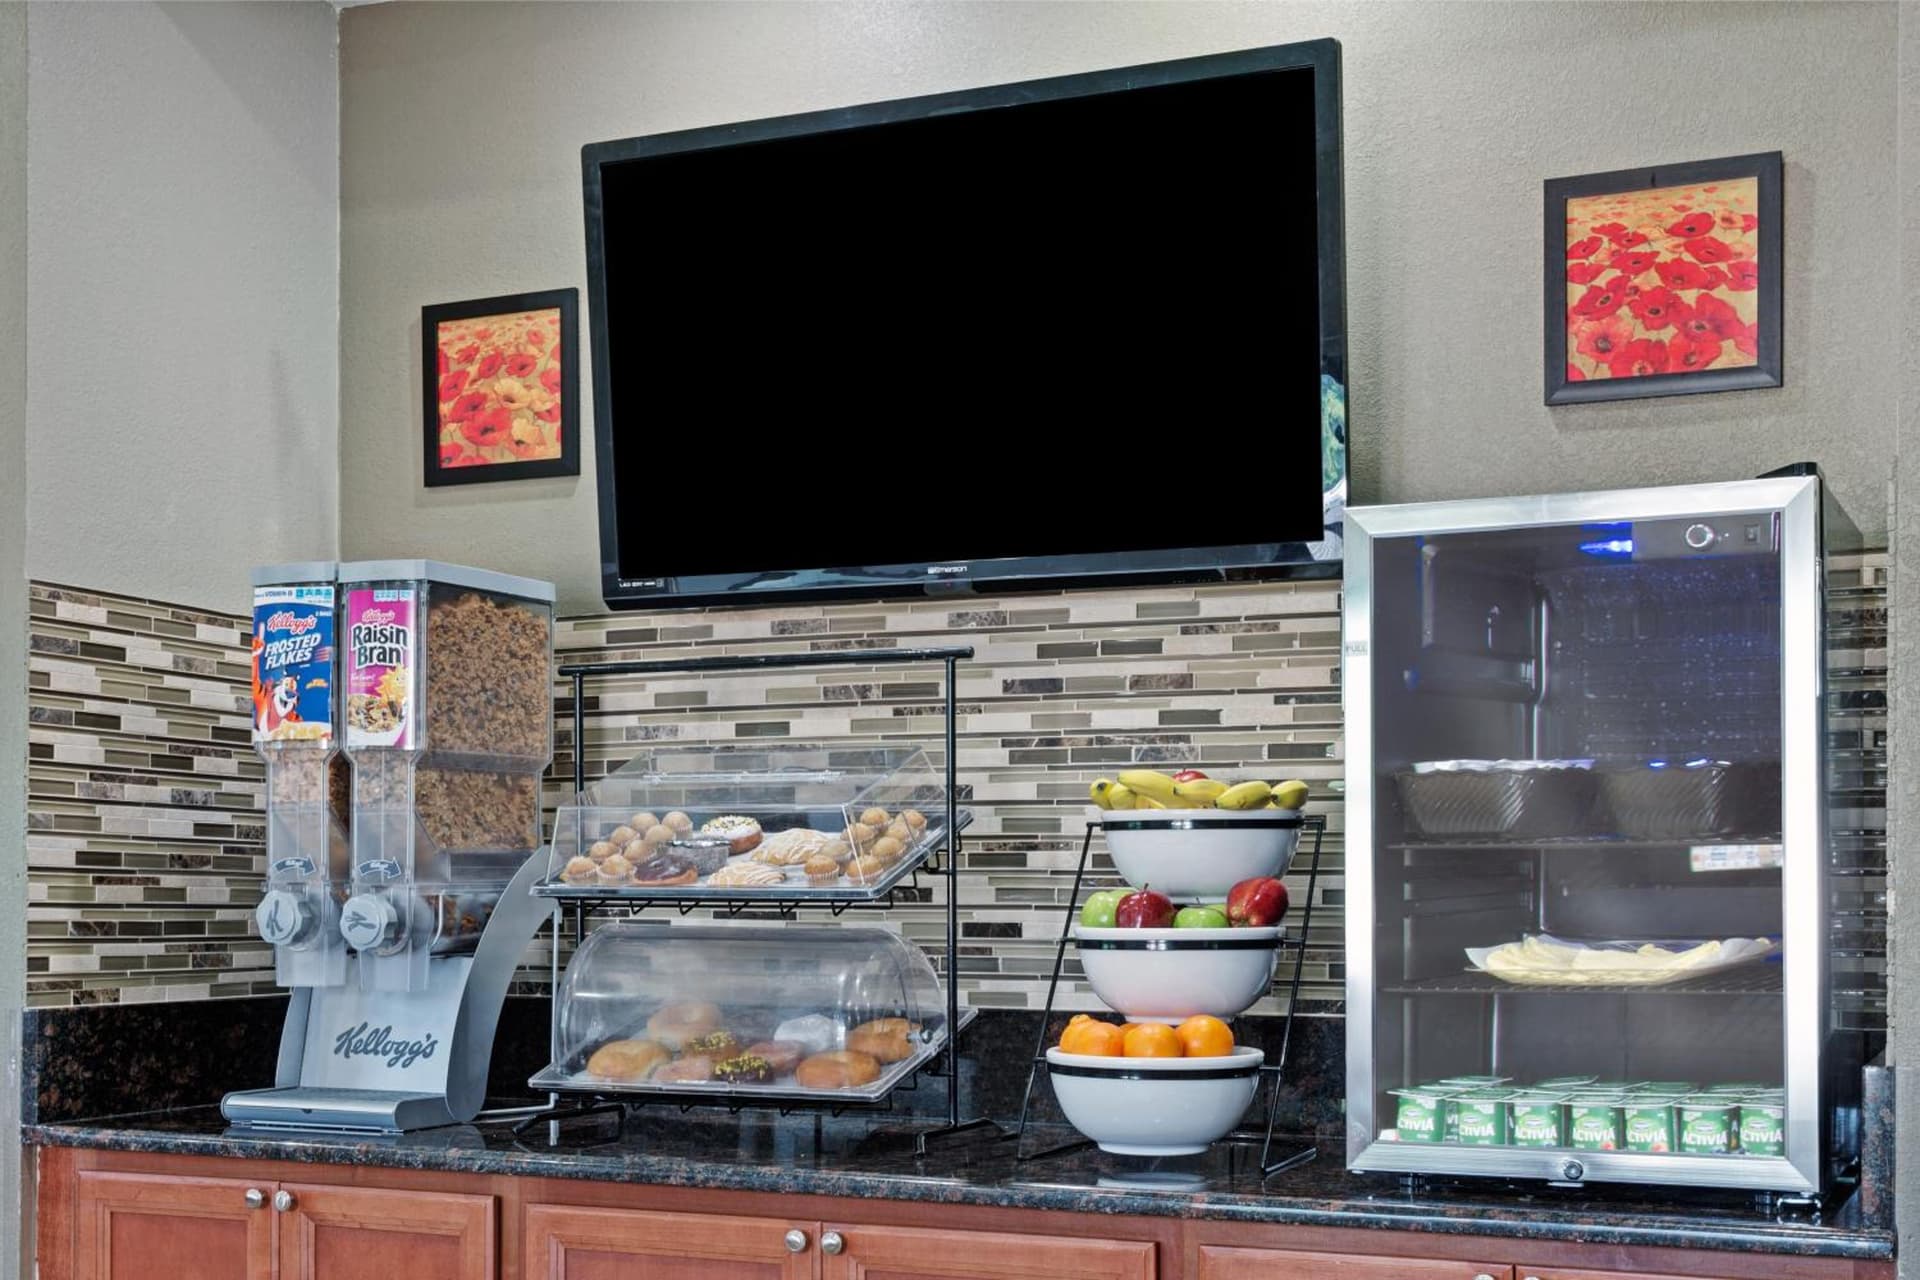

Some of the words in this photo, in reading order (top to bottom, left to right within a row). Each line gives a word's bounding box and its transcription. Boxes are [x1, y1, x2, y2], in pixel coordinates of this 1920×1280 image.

[267, 611, 317, 634] Kellogg's
[265, 633, 321, 658] FROSTED
[353, 626, 407, 648] Raisin
[265, 648, 313, 671] FLAKES
[357, 646, 401, 667] Bran
[334, 1021, 438, 1068] Kellogg's
[1397, 1117, 1434, 1131] CTIVIA
[1459, 1122, 1495, 1136] CTIVIA
